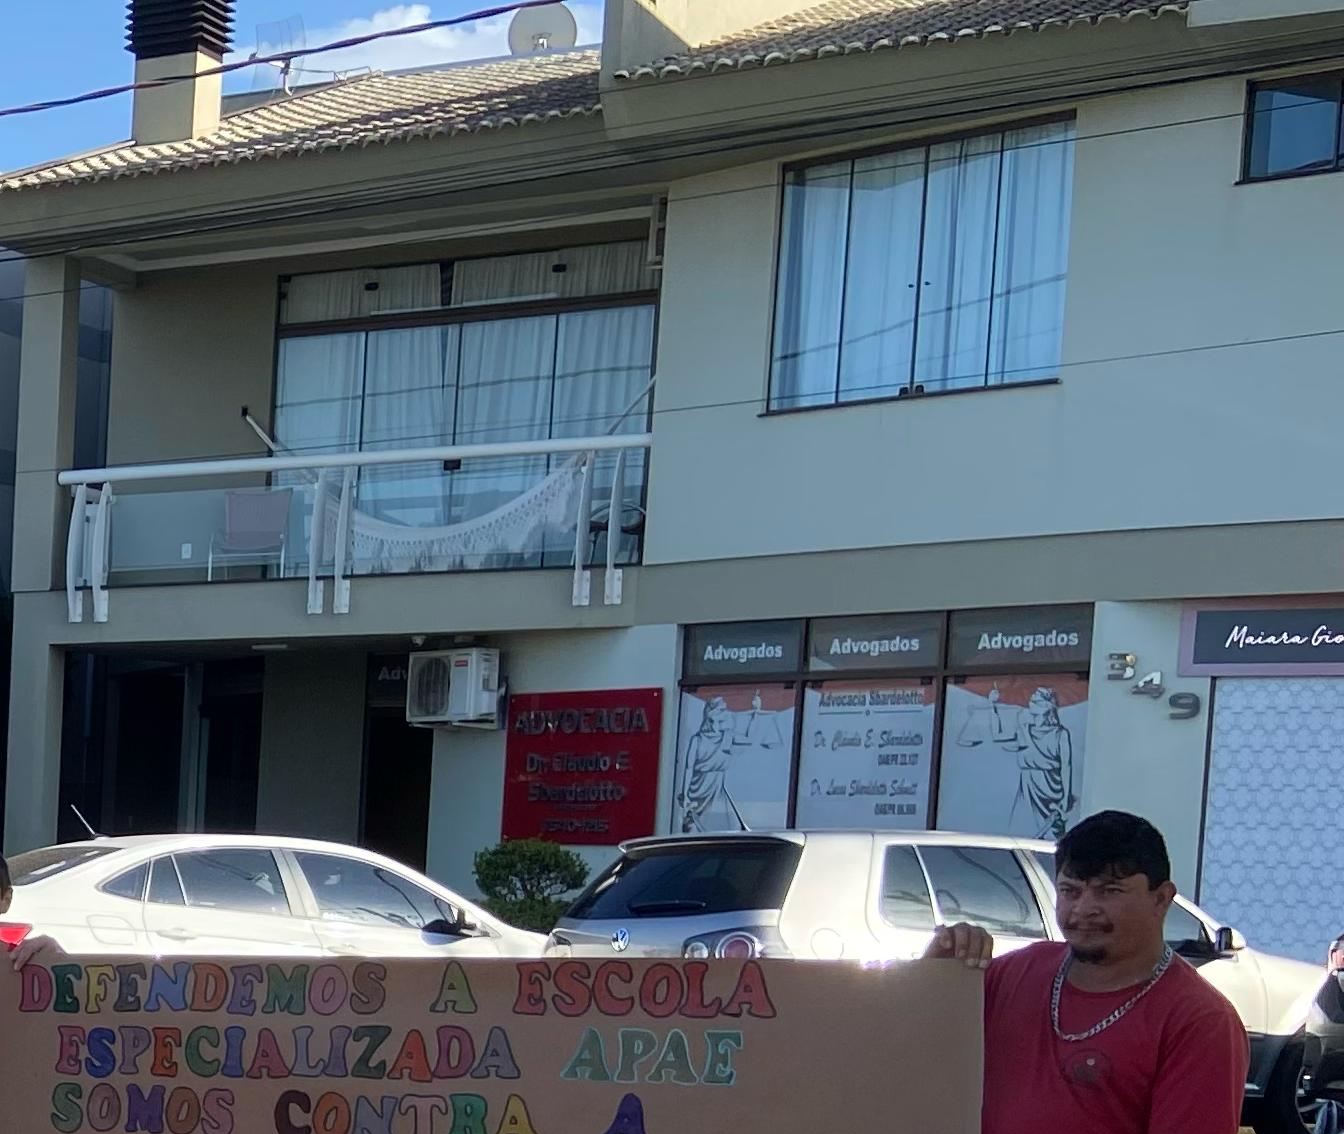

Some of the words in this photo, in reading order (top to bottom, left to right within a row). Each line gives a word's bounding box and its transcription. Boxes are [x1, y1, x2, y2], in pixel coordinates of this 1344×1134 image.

[829, 635, 920, 658] Advogados
[978, 629, 1080, 652] Advogados
[1224, 624, 1309, 650] Maiara
[703, 643, 783, 662] Advogados
[1107, 652, 1201, 720] 349
[515, 707, 650, 735] ADVOCACIA
[18, 961, 389, 1018] DEFENDEMOS
[429, 959, 479, 1015] A
[513, 959, 777, 1019] ESCOLA
[54, 1025, 521, 1081] ESPECIALIZADA
[559, 1026, 745, 1087] APAE
